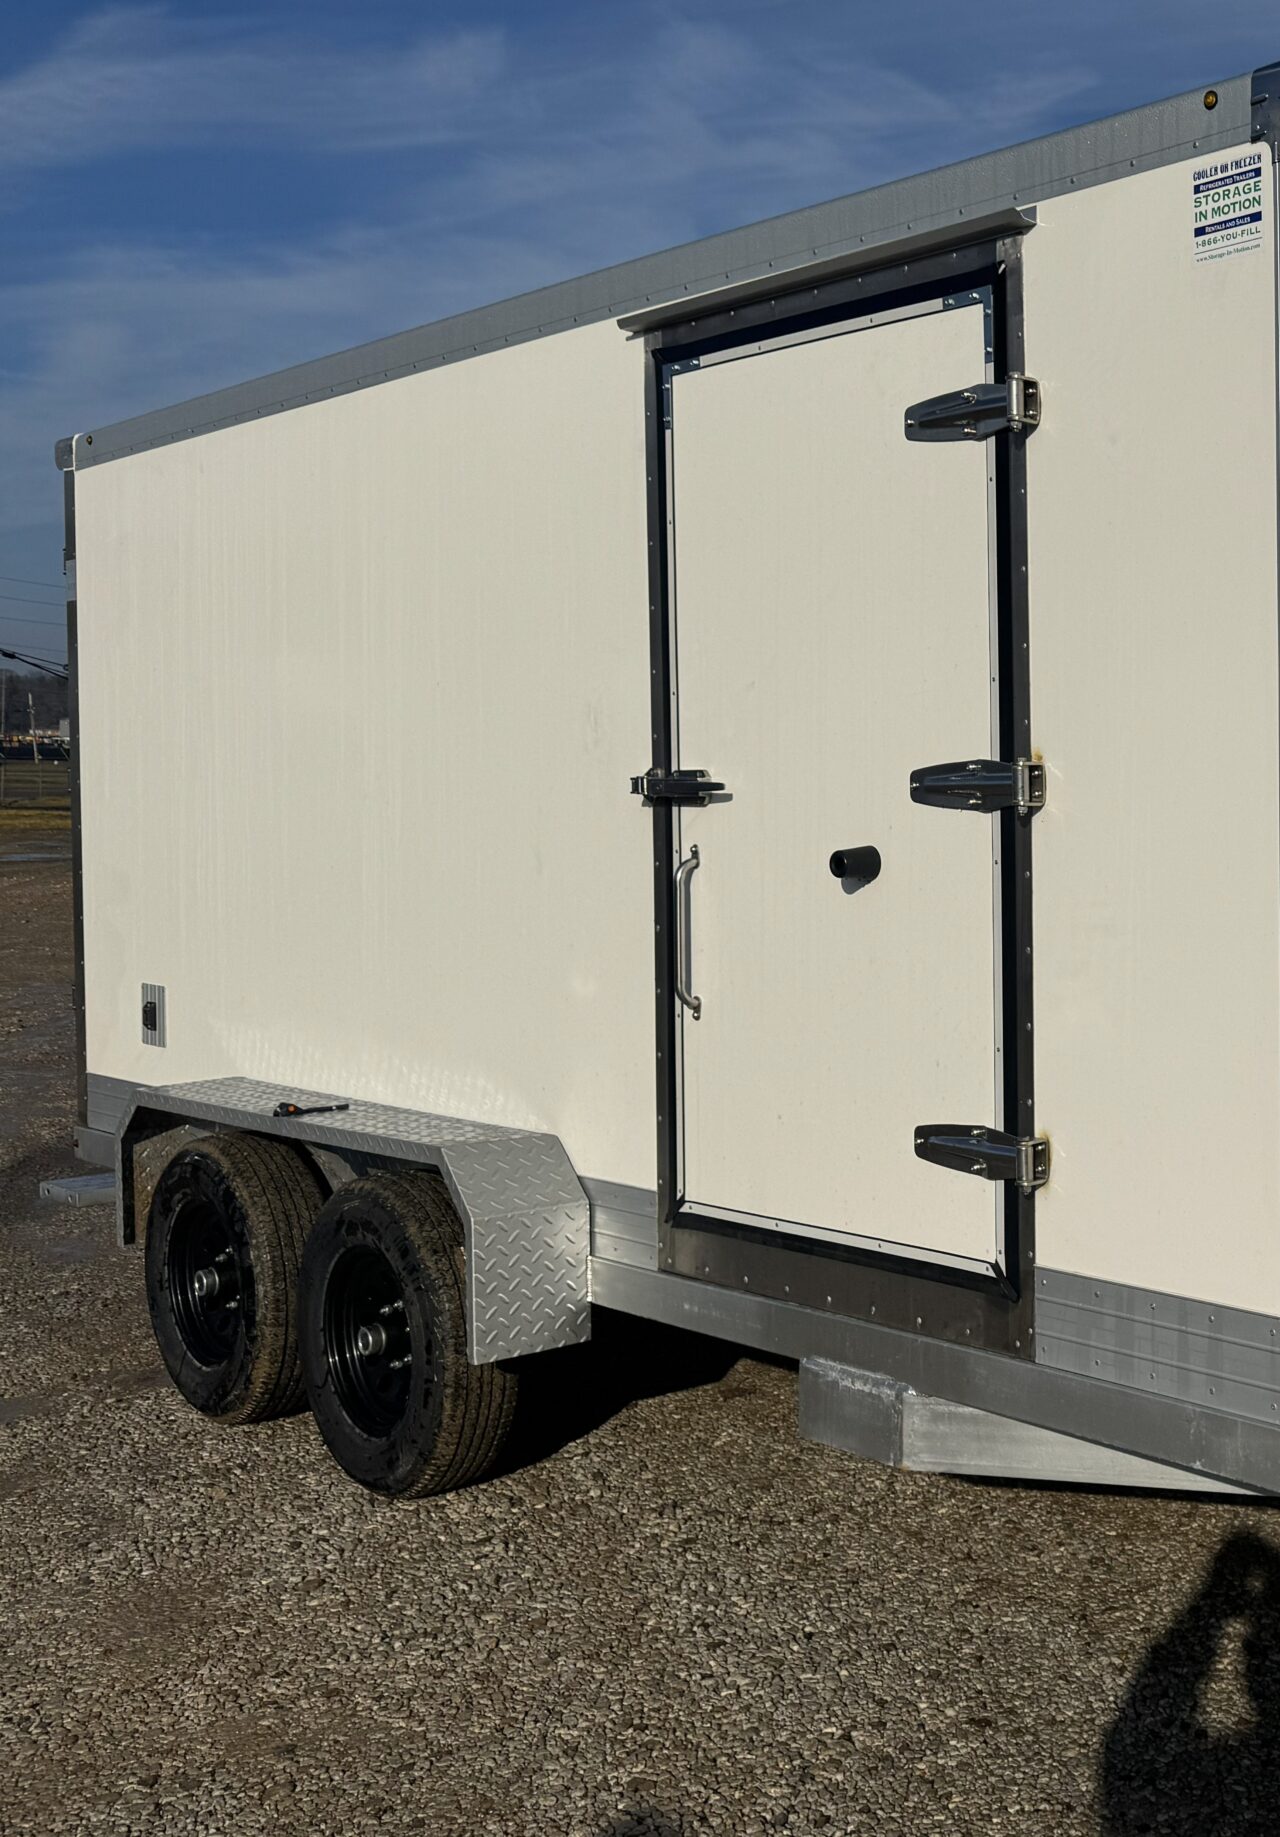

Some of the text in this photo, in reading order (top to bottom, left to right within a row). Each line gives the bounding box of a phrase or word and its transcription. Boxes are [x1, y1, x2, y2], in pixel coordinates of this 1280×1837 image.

[1193, 154, 1262, 182] COOLER OR FREEZER
[1194, 179, 1262, 209] STORAGE
[1199, 171, 1255, 192] REFRIGERATED TRAILERS
[1194, 194, 1262, 223] IN MOTION
[1195, 225, 1261, 249] 1-866-YOU-FILL
[1205, 216, 1251, 233] RENTALS AND SALES
